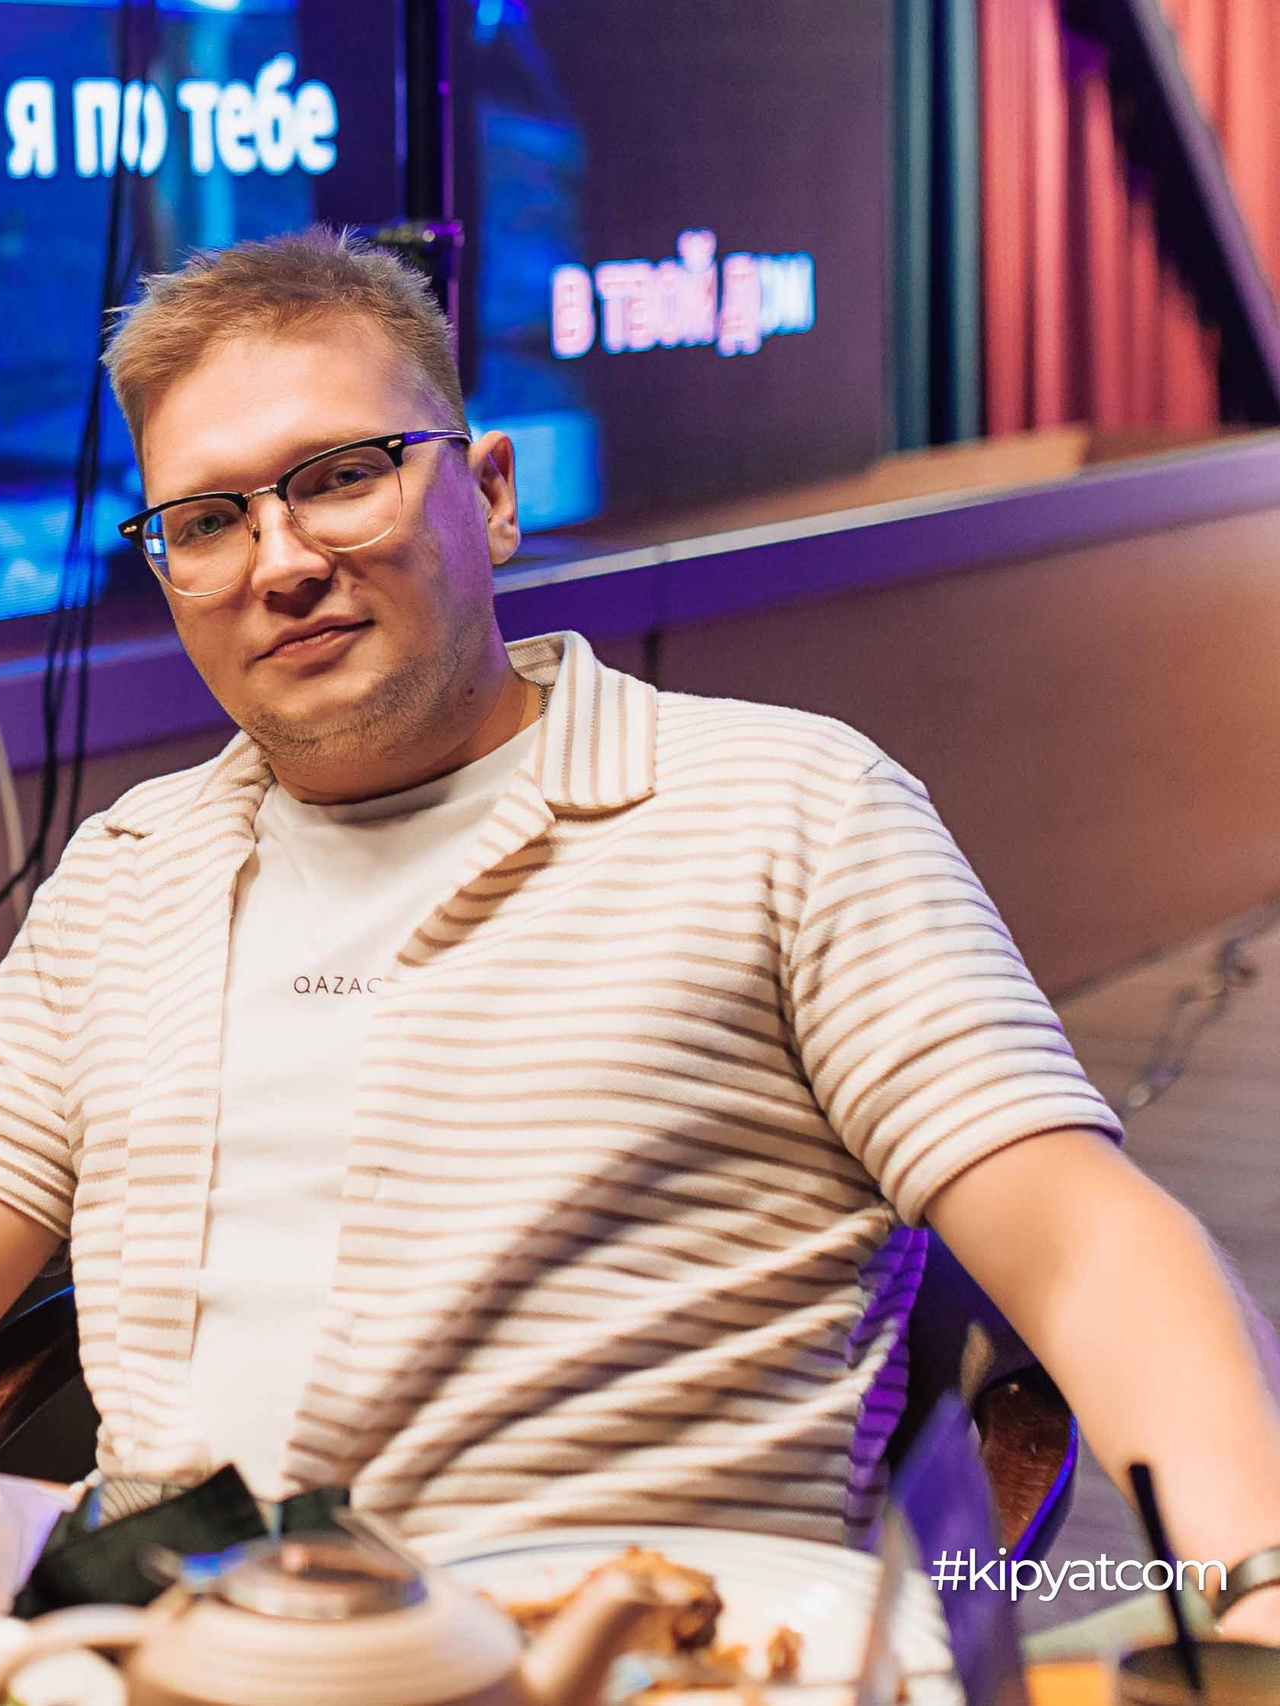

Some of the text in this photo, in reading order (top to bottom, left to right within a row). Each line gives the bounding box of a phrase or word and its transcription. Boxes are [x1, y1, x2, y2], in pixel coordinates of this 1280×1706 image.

[6, 77, 56, 178] я
[74, 77, 167, 178] по
[178, 53, 337, 175] тебе
